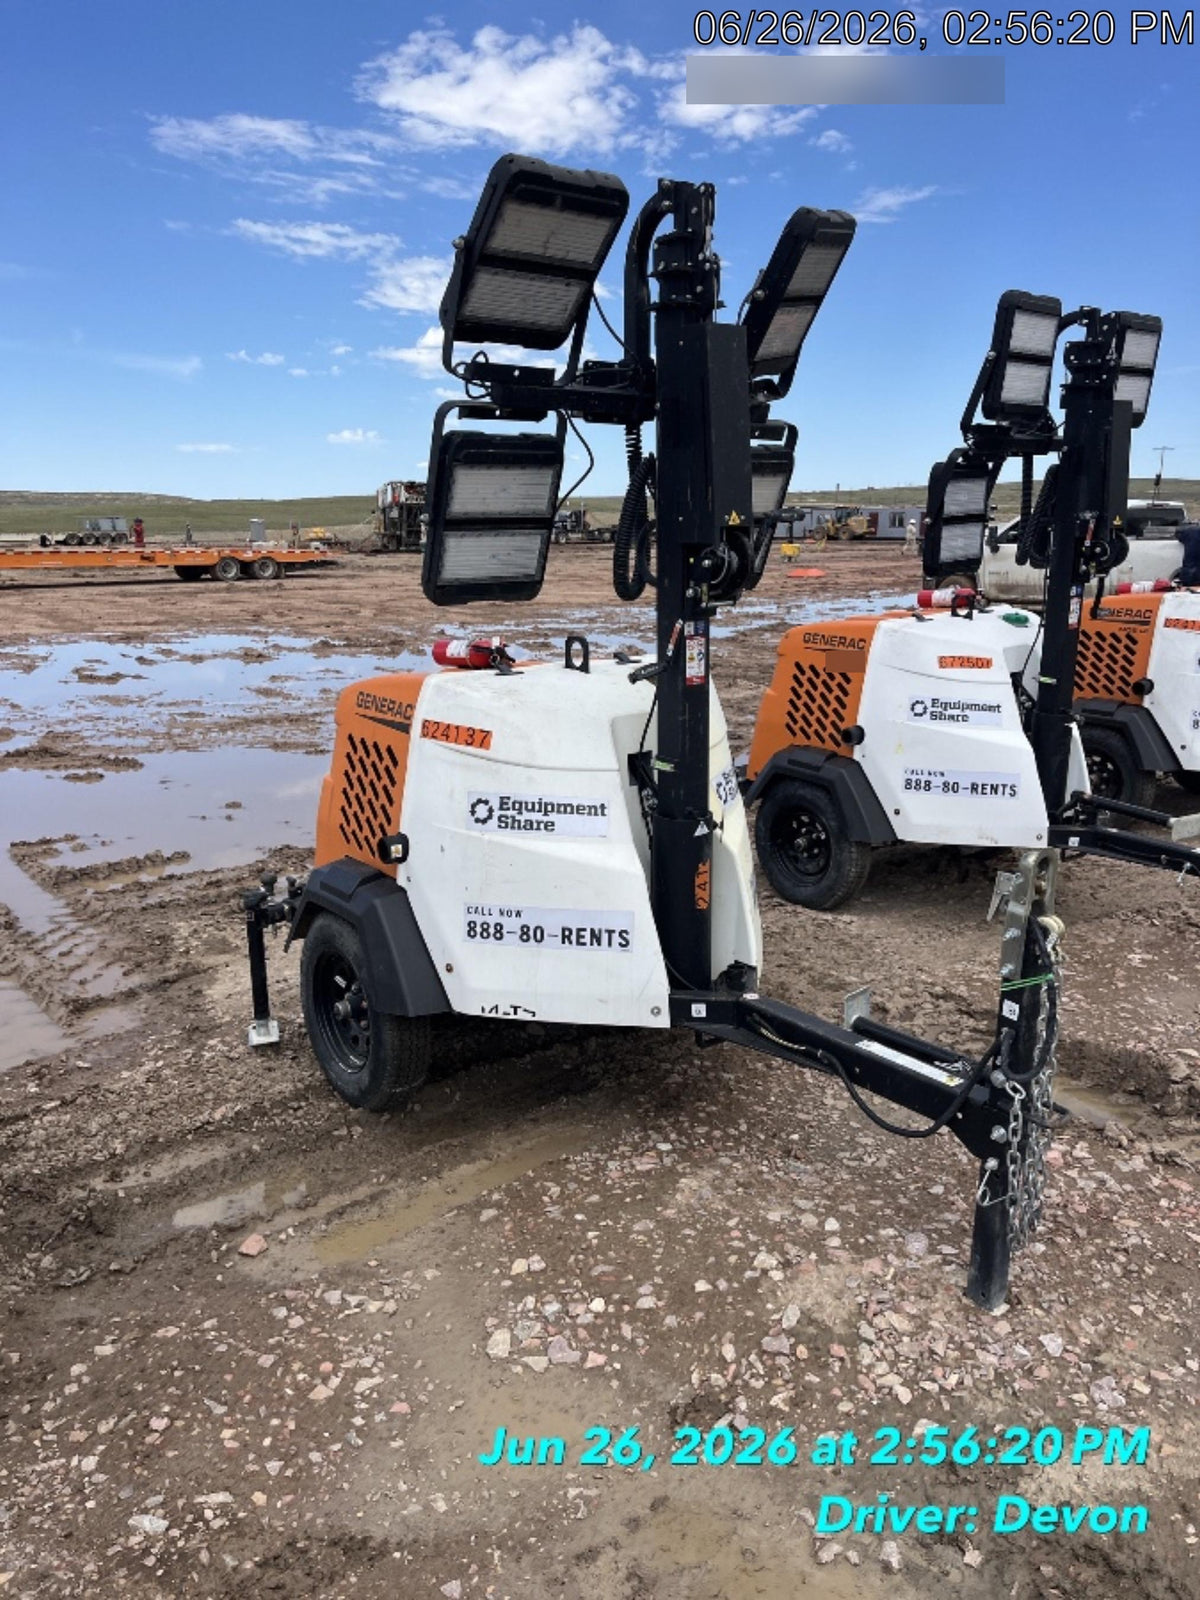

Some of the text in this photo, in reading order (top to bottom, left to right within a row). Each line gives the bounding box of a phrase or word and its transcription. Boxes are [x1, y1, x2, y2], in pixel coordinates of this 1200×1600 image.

[803, 632, 867, 650] GENERAC
[356, 691, 413, 721] GENERAC
[930, 698, 1002, 714] Equipment
[929, 710, 970, 723] Share
[421, 719, 491, 747] 624137
[904, 778, 1018, 797] 888-80-RENTS
[497, 796, 607, 817] Equipment
[497, 814, 555, 832] Share
[466, 906, 523, 919] CALL NOW
[466, 920, 631, 949] 888-80-RENTS
